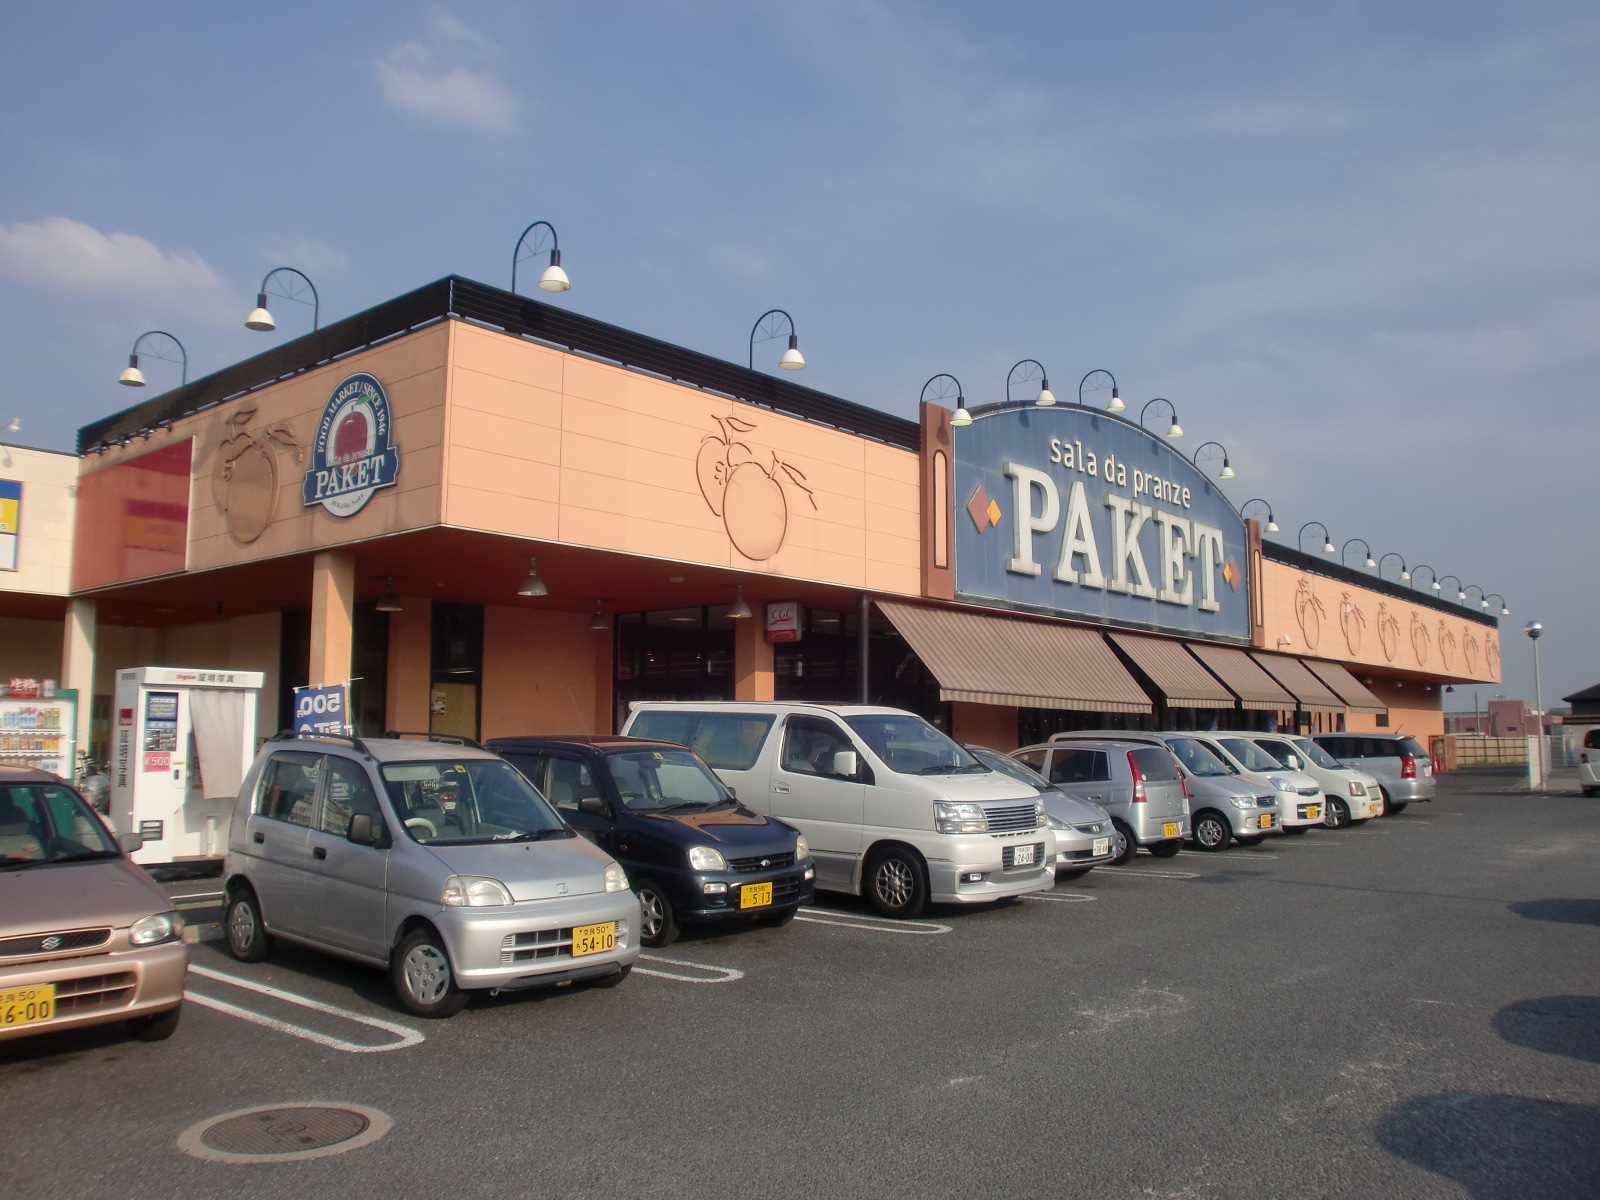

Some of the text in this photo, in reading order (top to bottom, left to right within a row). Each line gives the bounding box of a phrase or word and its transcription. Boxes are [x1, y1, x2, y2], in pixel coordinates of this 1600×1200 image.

[317, 416, 330, 453] FOOD
[376, 408, 386, 436] 1946
[314, 454, 385, 499] PAKET
[1050, 437, 1191, 509] sala da pranze
[1002, 461, 1225, 612] PAKET
[771, 608, 793, 620] CGC
[582, 934, 613, 953] 54-10
